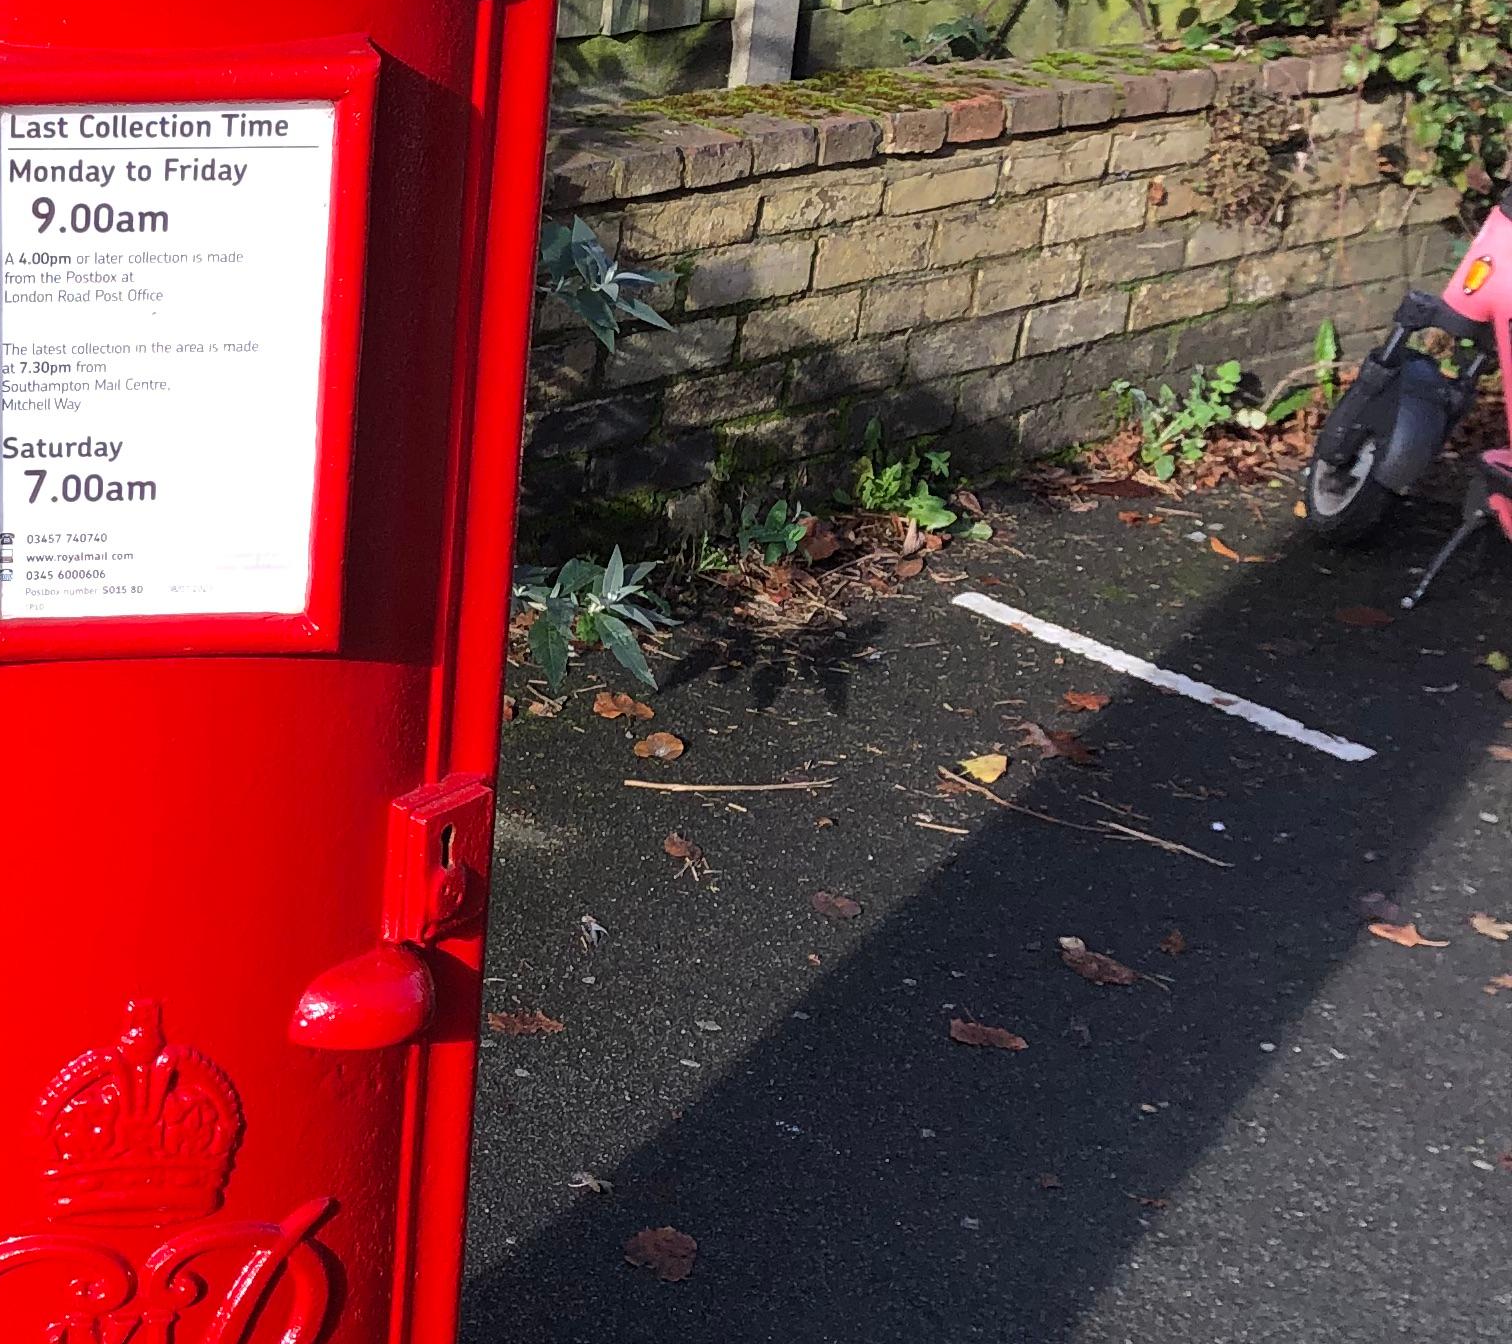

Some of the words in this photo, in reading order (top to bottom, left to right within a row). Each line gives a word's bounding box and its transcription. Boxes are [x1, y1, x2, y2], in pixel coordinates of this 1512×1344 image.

[10, 114, 69, 138] Last
[79, 114, 212, 138] Collection
[221, 113, 289, 137] Time
[10, 159, 115, 188] Monday
[126, 161, 151, 182] to
[165, 158, 247, 186] Friday
[32, 197, 168, 234] 9.00am
[4, 253, 15, 265] A
[19, 252, 71, 267] 4.00pm
[76, 255, 90, 265] or
[95, 252, 123, 264] later
[129, 251, 187, 264] collection
[193, 254, 202, 263] is
[208, 251, 243, 262] made
[4, 270, 36, 284] from
[41, 272, 61, 283] the
[67, 271, 116, 283] Postbox
[122, 272, 134, 282] at
[4, 289, 53, 303] London
[58, 290, 90, 302] Road
[96, 290, 123, 302] Post
[128, 289, 163, 301] Office
[2, 342, 28, 356] The
[33, 343, 66, 355] latest
[72, 343, 130, 354] collection
[135, 344, 147, 354] in
[152, 342, 171, 353] the
[176, 344, 204, 352] area
[209, 344, 218, 352] is
[224, 341, 258, 352] made
[1, 363, 16, 375] at
[19, 361, 72, 375] 7.30pm
[77, 361, 106, 372] from
[0, 379, 90, 394] Southampton
[95, 379, 120, 390] Mail
[1, 399, 51, 411] Mitchell
[54, 398, 81, 412] Way
[2, 436, 123, 461] Saturday
[24, 469, 156, 504] 7.00am
[27, 534, 61, 544] 03457
[66, 533, 107, 543] 740740
[26, 552, 133, 563] www.royalmailcom
[26, 570, 54, 581] 0345
[57, 569, 106, 580] 6000606
